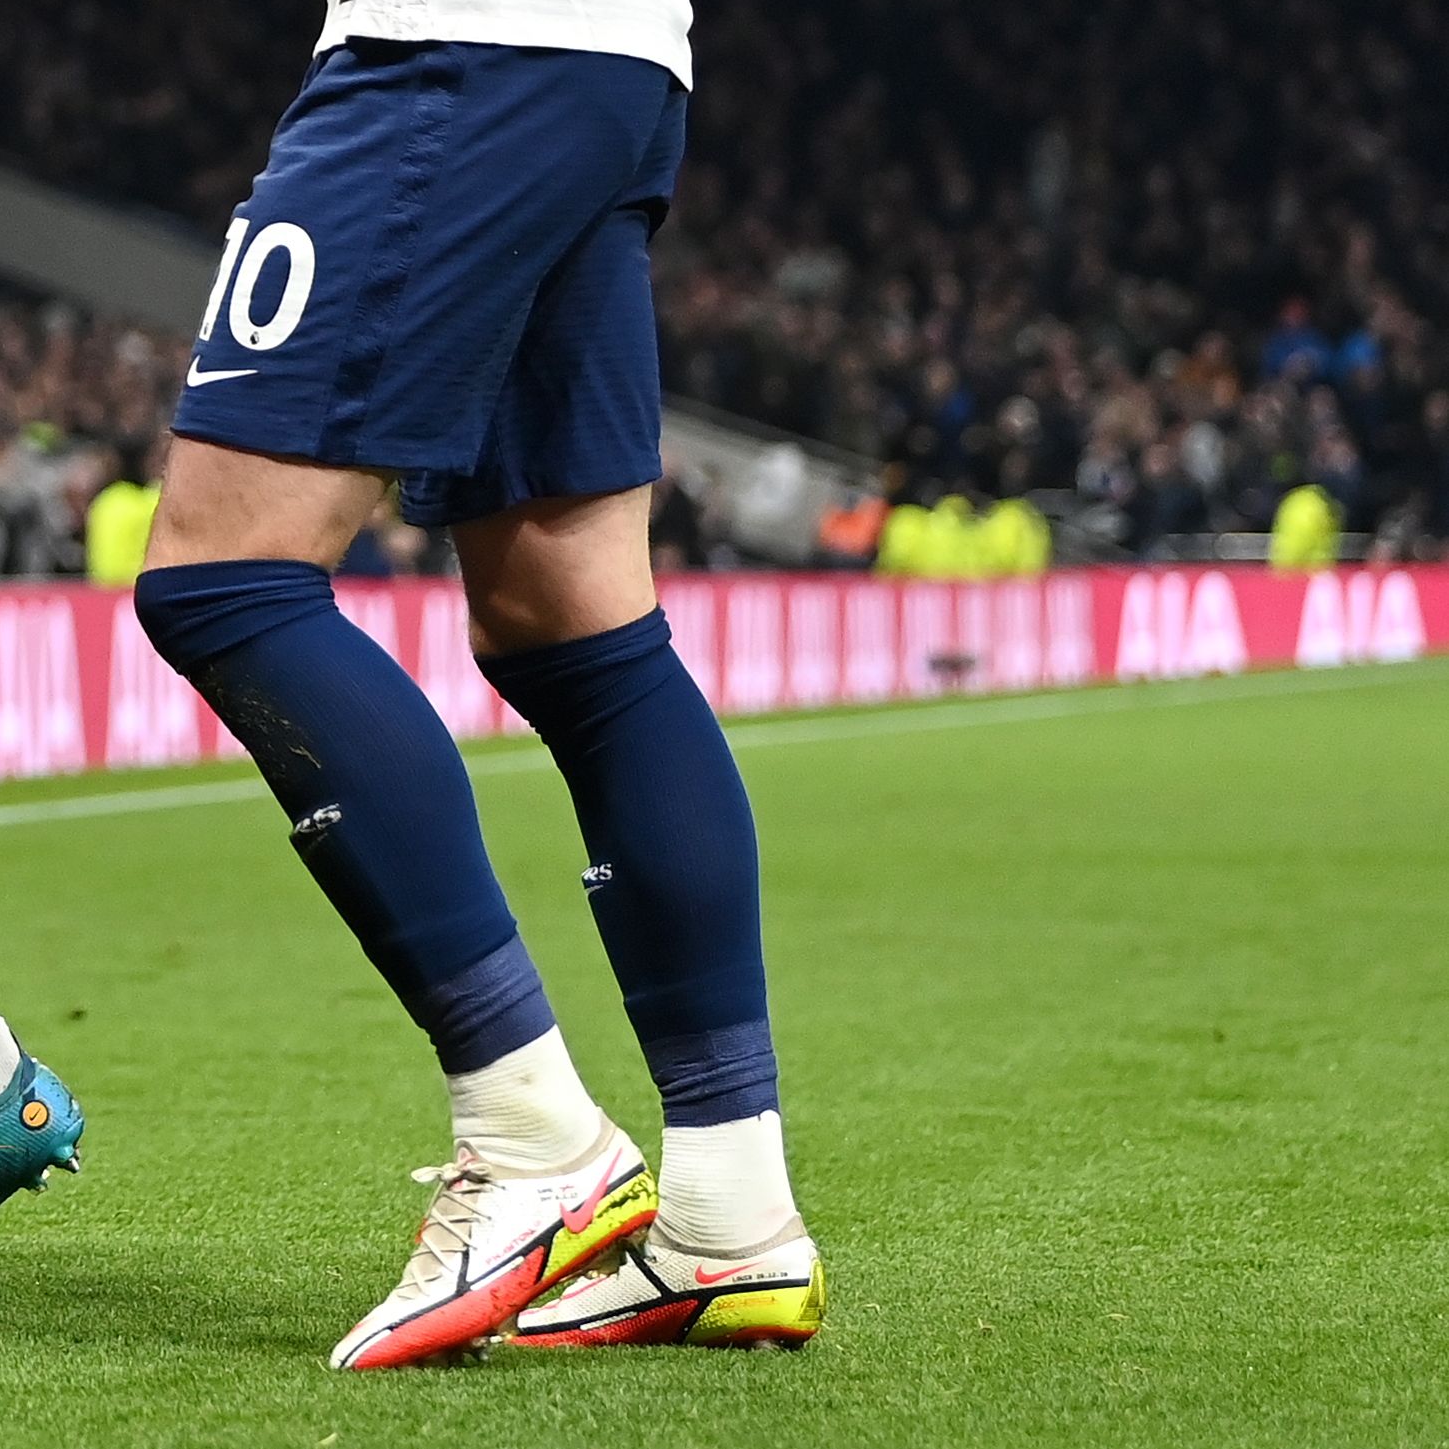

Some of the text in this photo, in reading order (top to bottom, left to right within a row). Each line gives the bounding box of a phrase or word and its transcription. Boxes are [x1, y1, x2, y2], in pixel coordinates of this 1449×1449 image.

[199, 216, 316, 351] 10
[1113, 570, 1250, 684] AIA
[1294, 569, 1428, 668] AIA
